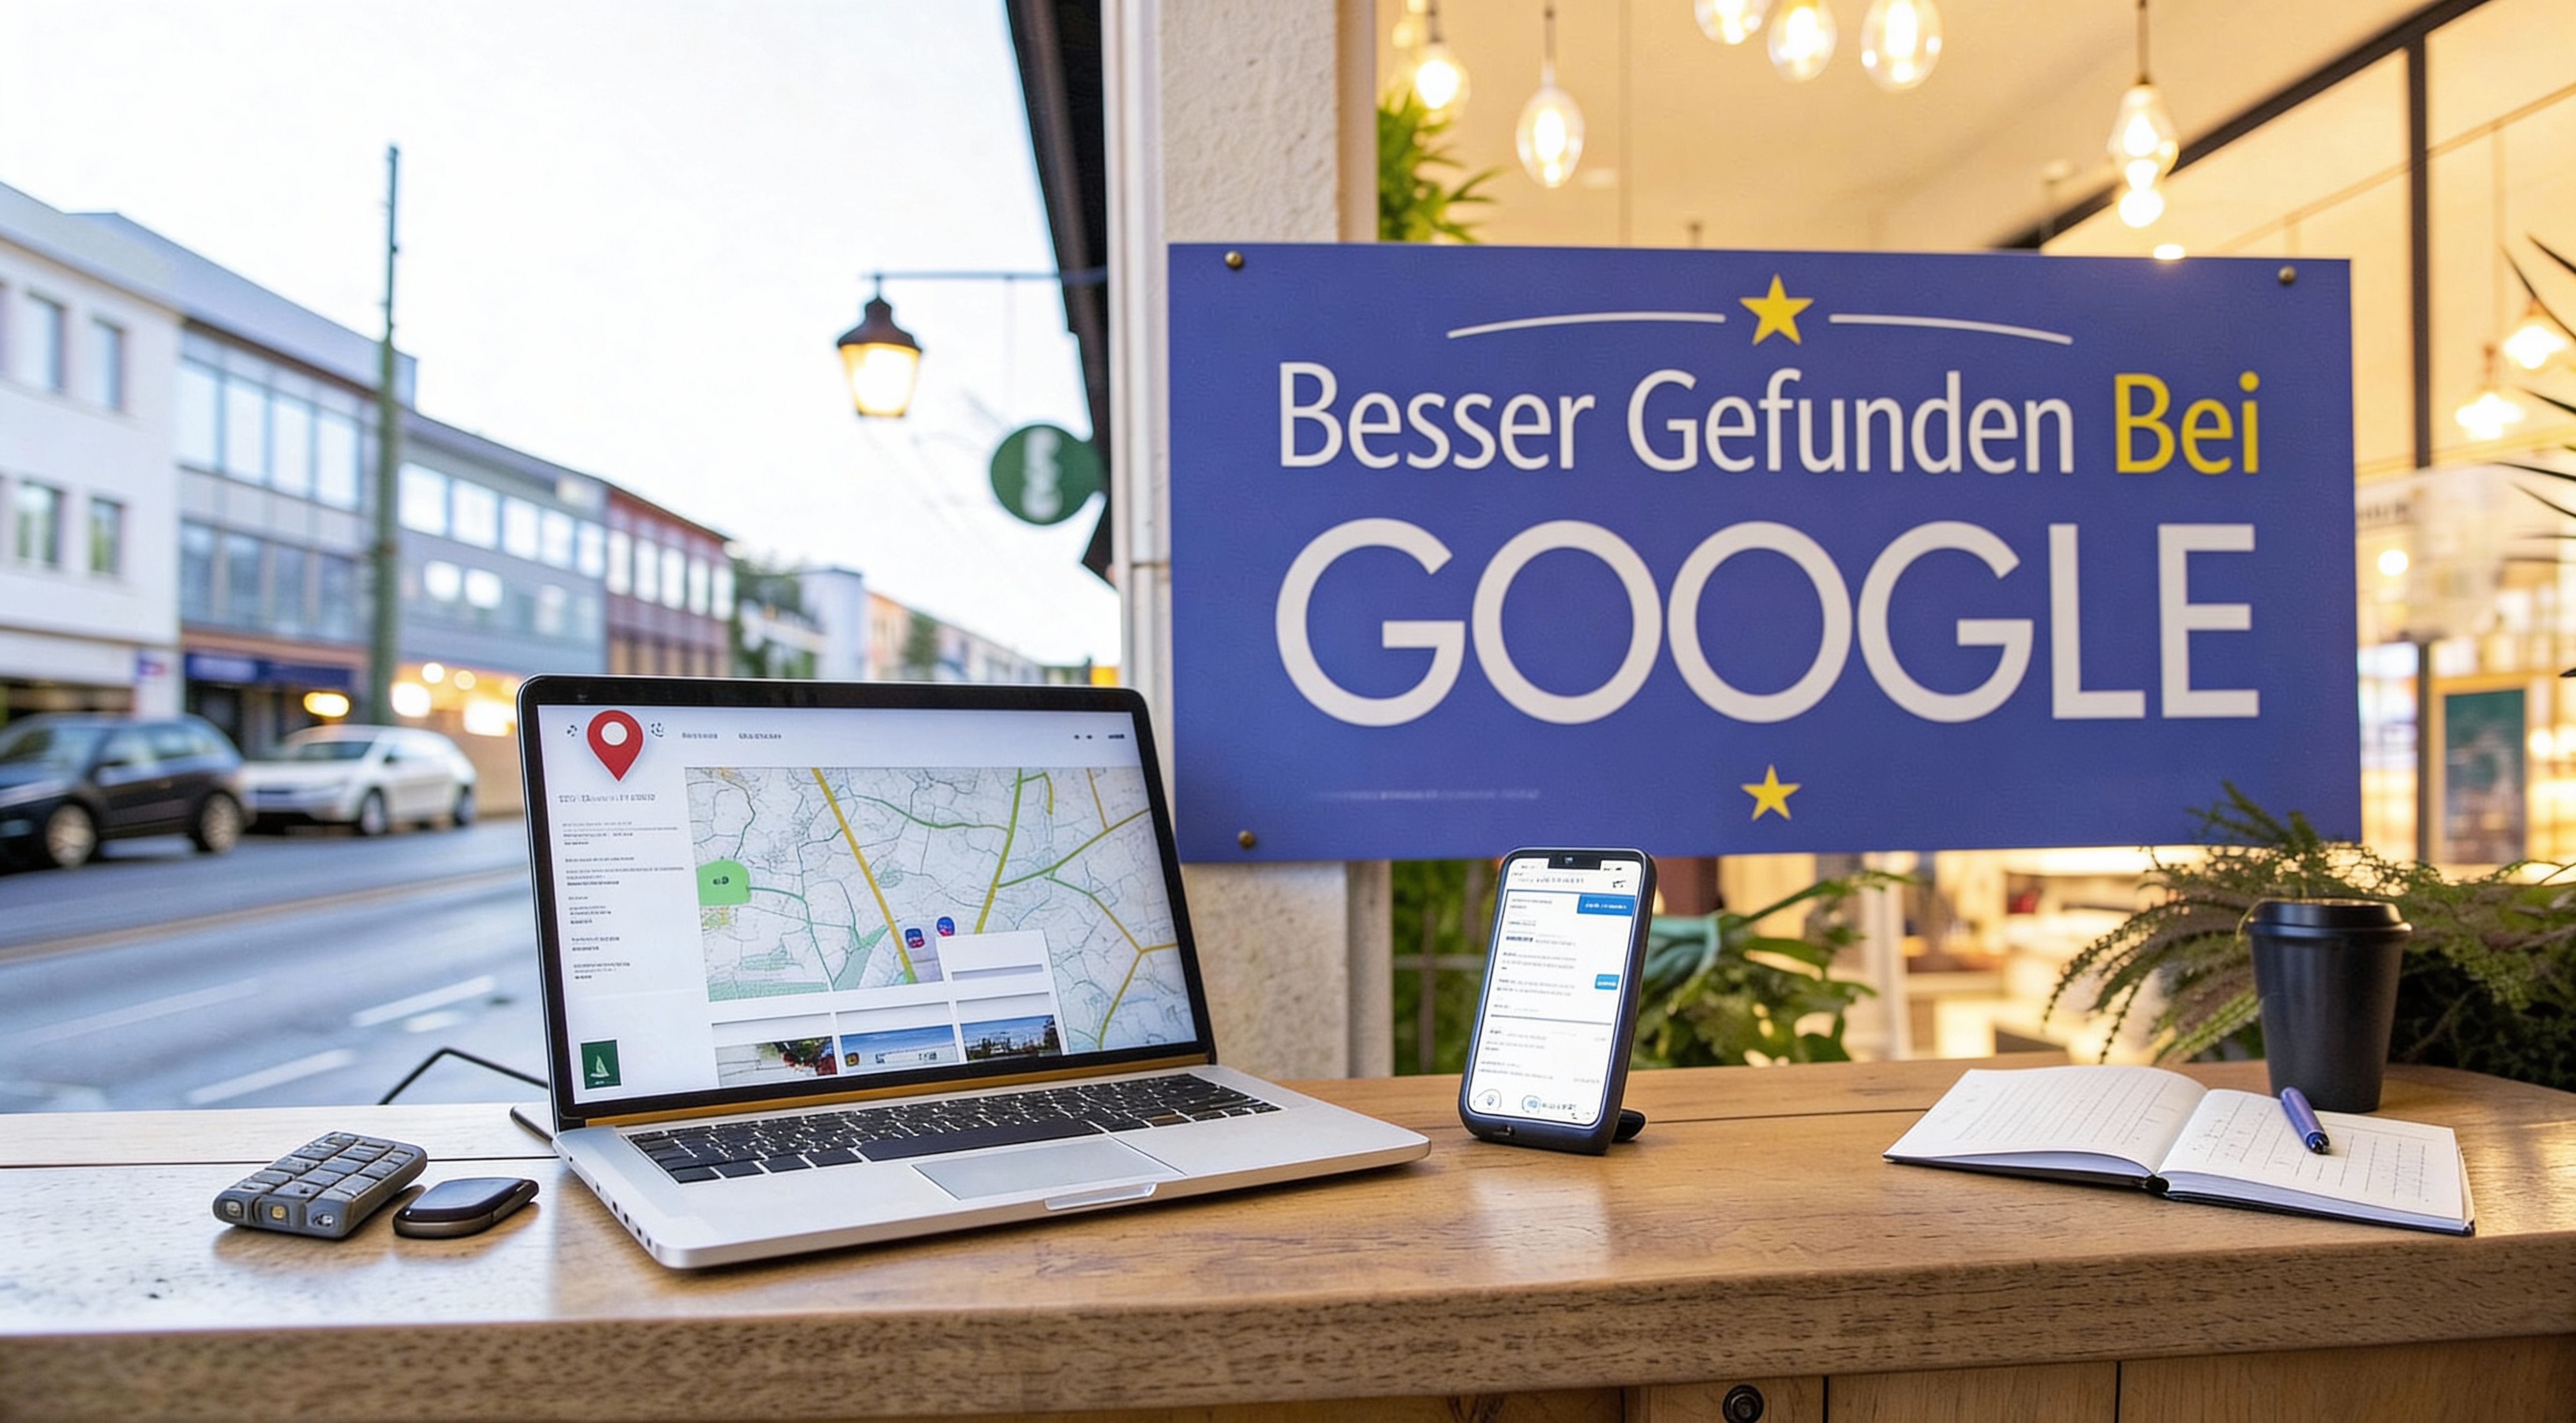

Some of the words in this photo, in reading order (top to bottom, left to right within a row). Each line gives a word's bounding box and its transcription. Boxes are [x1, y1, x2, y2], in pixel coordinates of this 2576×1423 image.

[1280, 362, 1595, 469] Besser
[1628, 369, 2073, 474] Gefunden
[2115, 372, 2259, 474] Bei
[1276, 518, 2259, 726] GOOGLE
